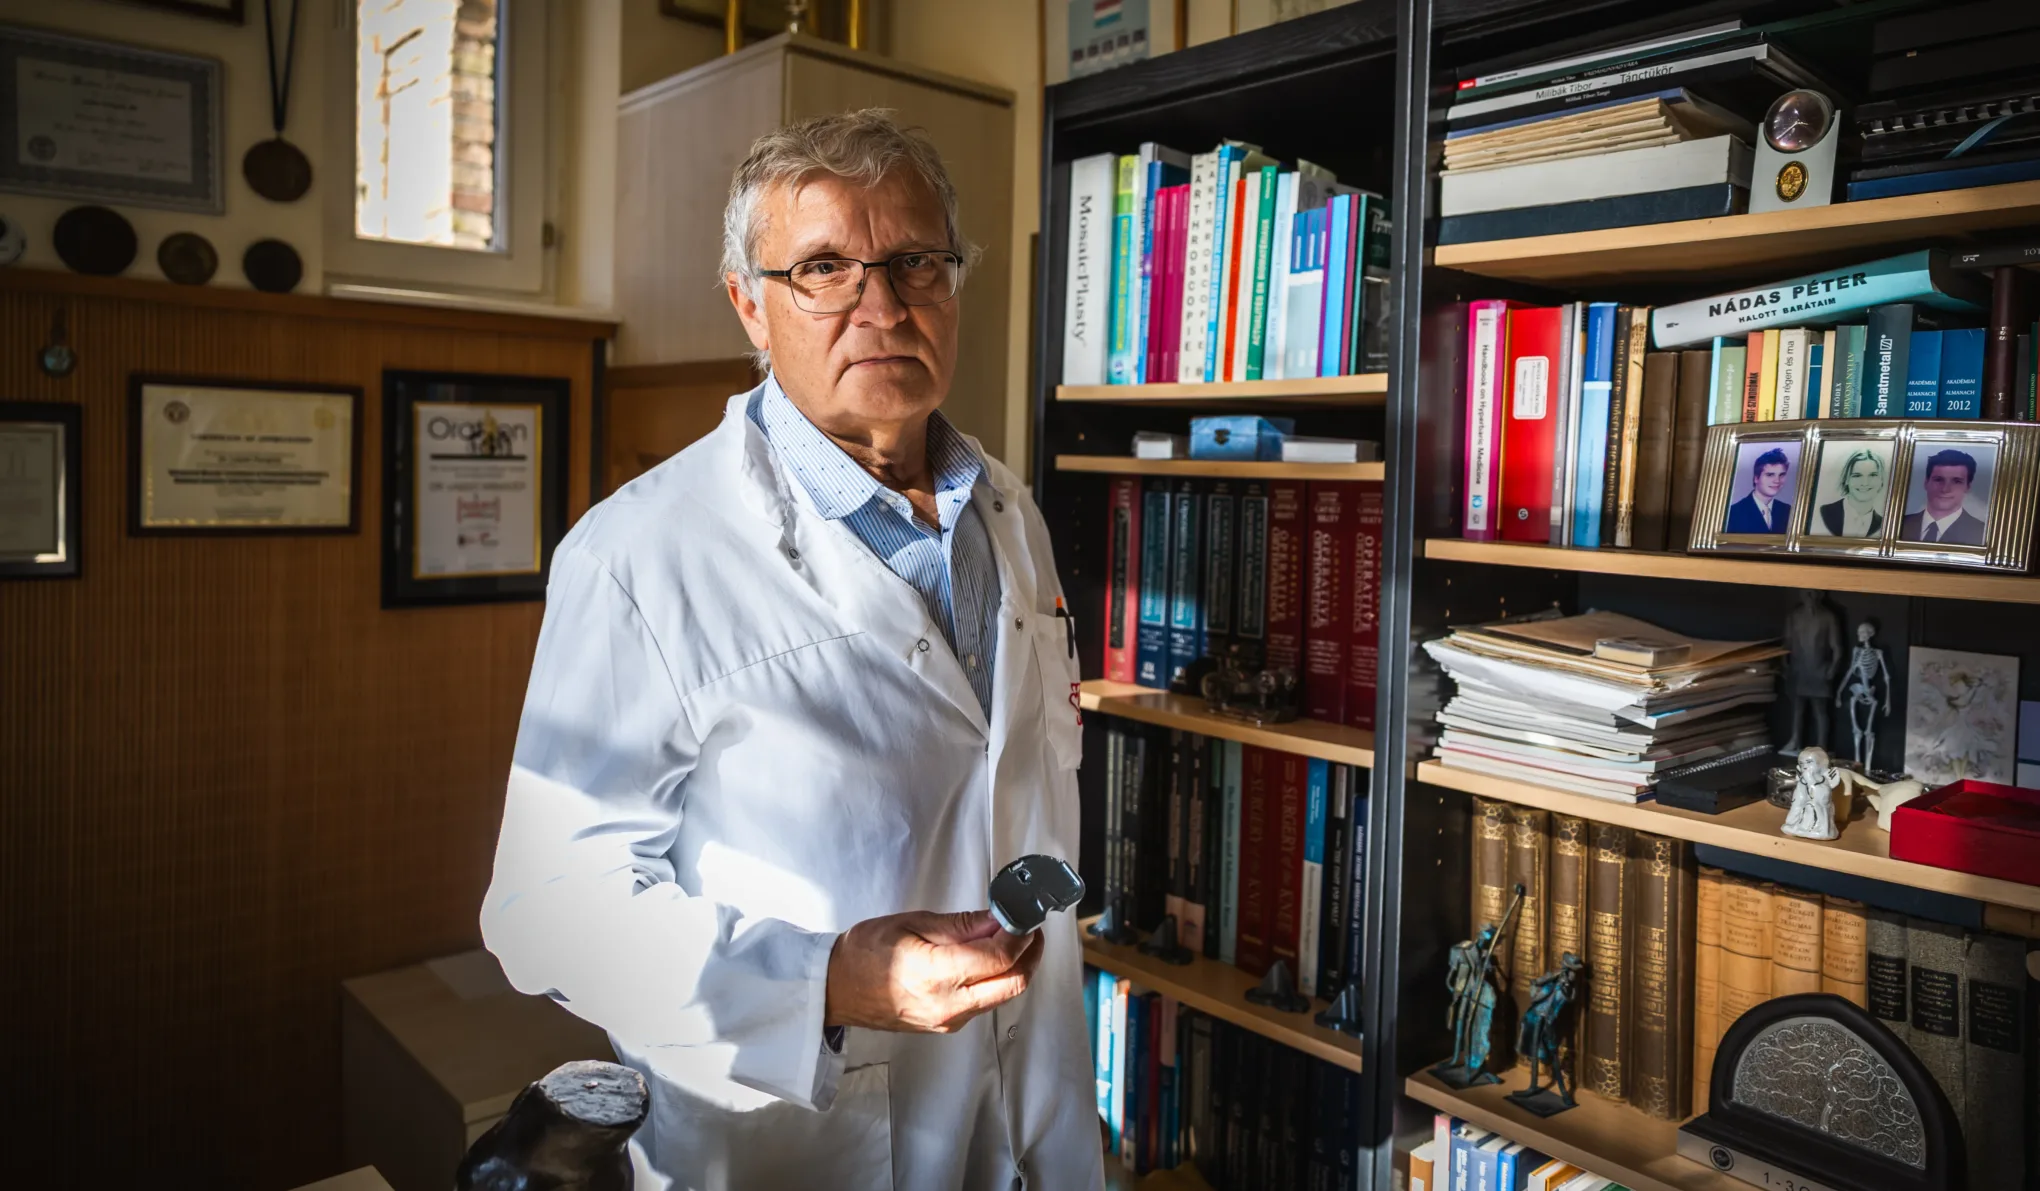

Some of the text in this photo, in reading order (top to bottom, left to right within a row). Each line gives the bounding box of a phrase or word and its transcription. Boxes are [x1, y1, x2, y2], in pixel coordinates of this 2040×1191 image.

[1535, 84, 1568, 99] Milibák
[1569, 81, 1593, 94] Tibor
[1620, 64, 1674, 84] Tánctükör
[1071, 194, 1093, 342] MosaicPlasty
[1708, 271, 1868, 318] NÁDAS PÉTER
[1738, 297, 1837, 324] HALOTT BARÁTAIM
[1252, 295, 1265, 347] ACTUALITÉS
[1784, 356, 1794, 367] és
[1787, 340, 1795, 354] ma
[1782, 369, 1794, 393] régen
[1832, 382, 1842, 407] KÓDEX
[1874, 351, 1892, 416] Sanatmetal
[1475, 344, 1489, 485] Handbook on Hyperbaric Medicine
[1908, 401, 1932, 412] 2012
[1947, 400, 1971, 411] 2012
[1319, 532, 1333, 627] OPERATIVE
[1361, 535, 1377, 633] OPERATIVE
[1281, 784, 1298, 853] SURGERY
